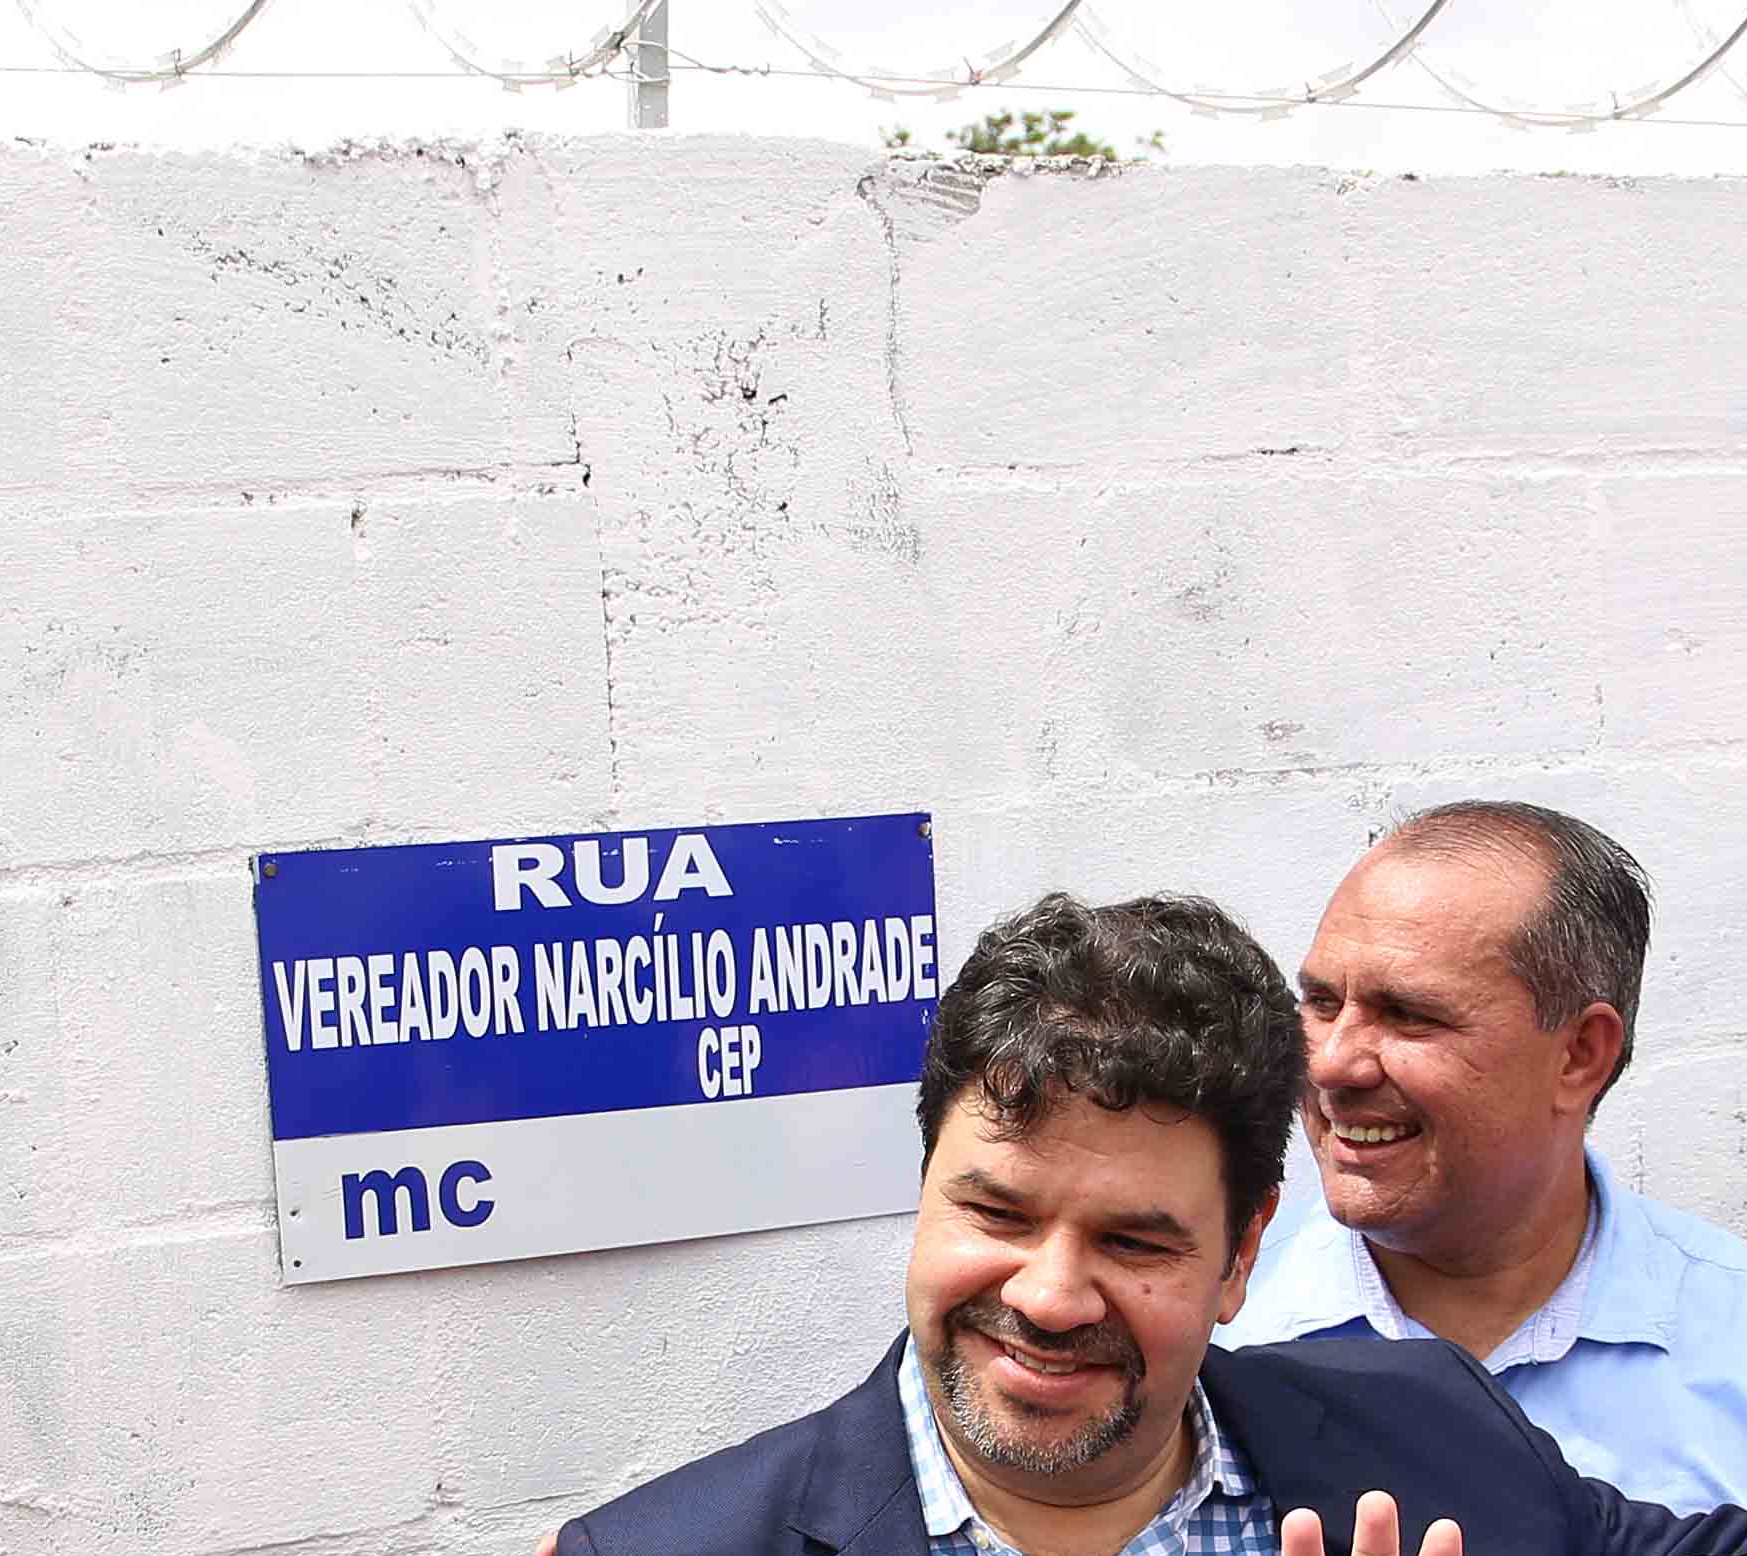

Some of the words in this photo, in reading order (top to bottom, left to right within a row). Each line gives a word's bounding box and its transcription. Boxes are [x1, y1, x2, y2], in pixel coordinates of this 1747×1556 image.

[492, 833, 734, 911] RUA
[273, 945, 525, 1052] VEREADOR
[534, 913, 737, 1030] NARCÍLIO
[750, 914, 937, 1014] ANDRADE
[697, 1025, 762, 1099] CEP
[341, 1158, 495, 1240] mc
